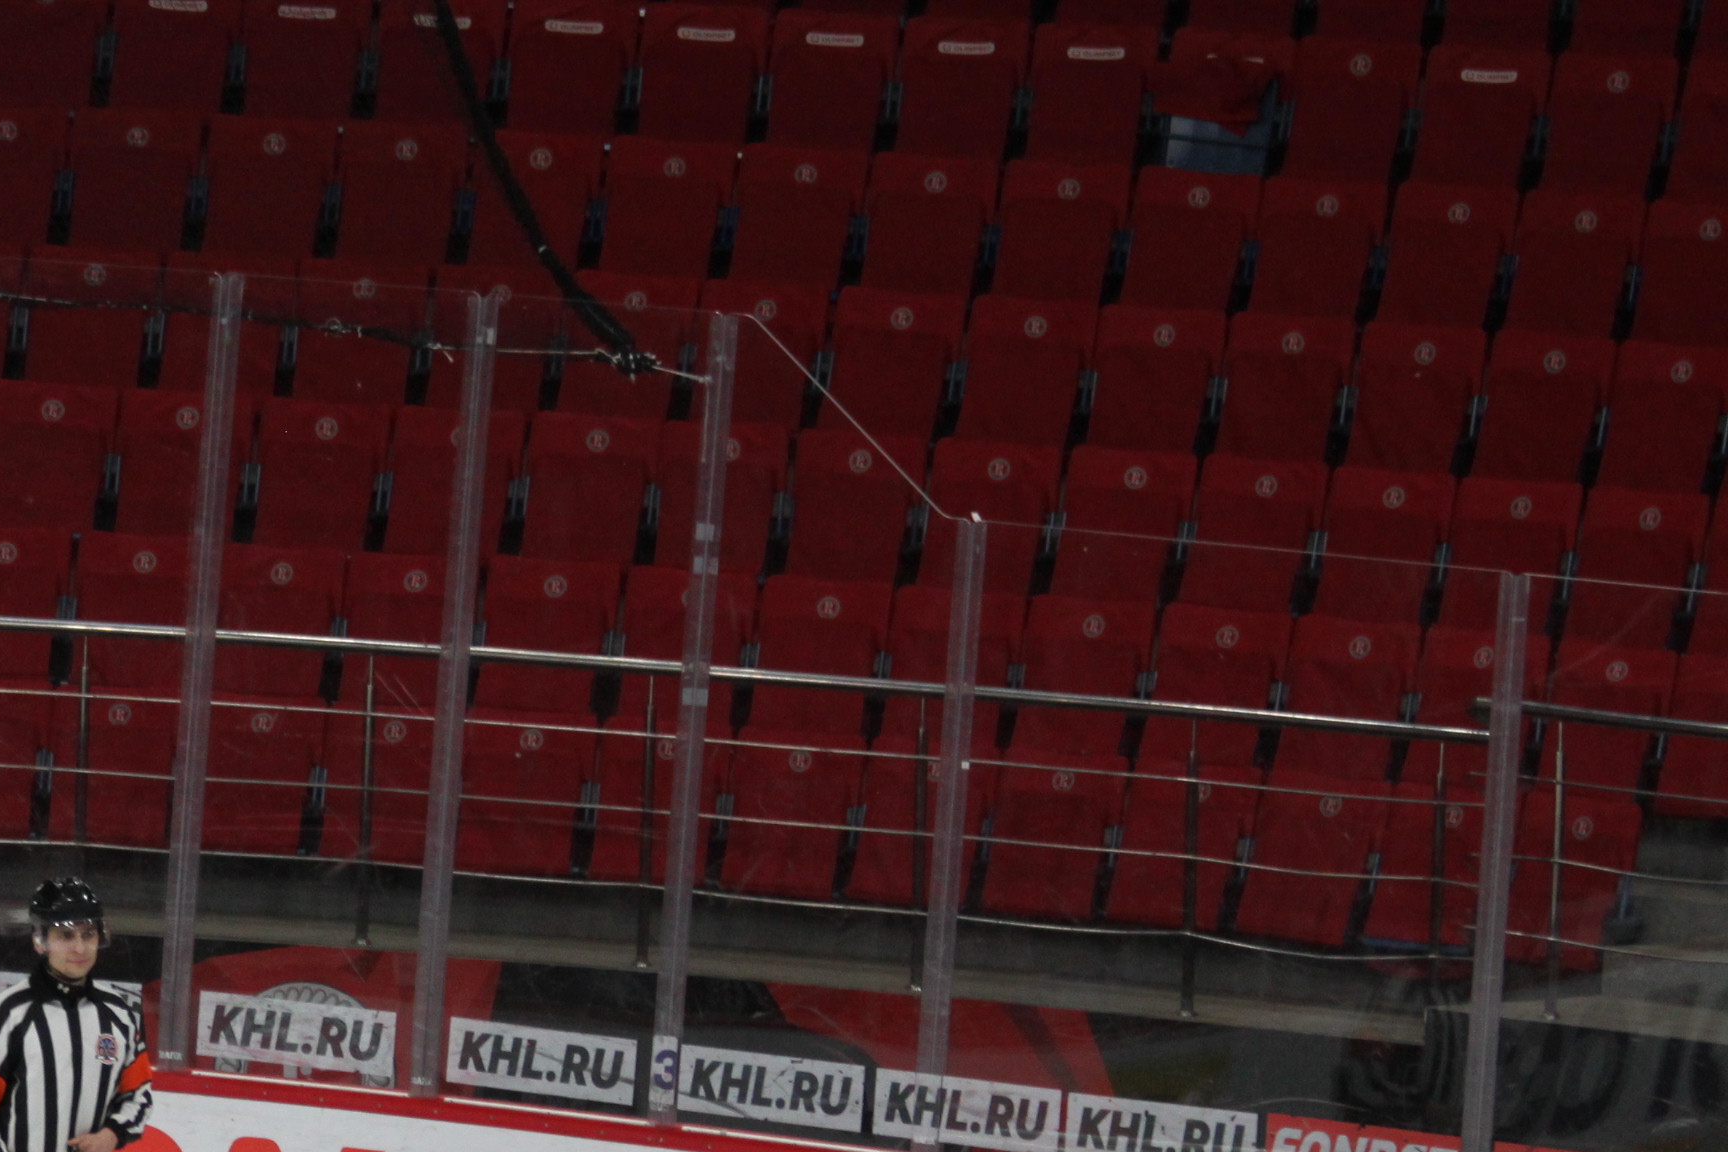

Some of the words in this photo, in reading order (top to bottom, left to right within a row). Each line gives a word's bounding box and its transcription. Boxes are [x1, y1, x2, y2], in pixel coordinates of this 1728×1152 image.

[209, 1004, 383, 1062] KHL.RU
[458, 1030, 625, 1090] KHL.RU
[653, 1049, 678, 1091] 3
[690, 1058, 853, 1116] KHL.RU
[884, 1083, 1049, 1141] KHL.RU
